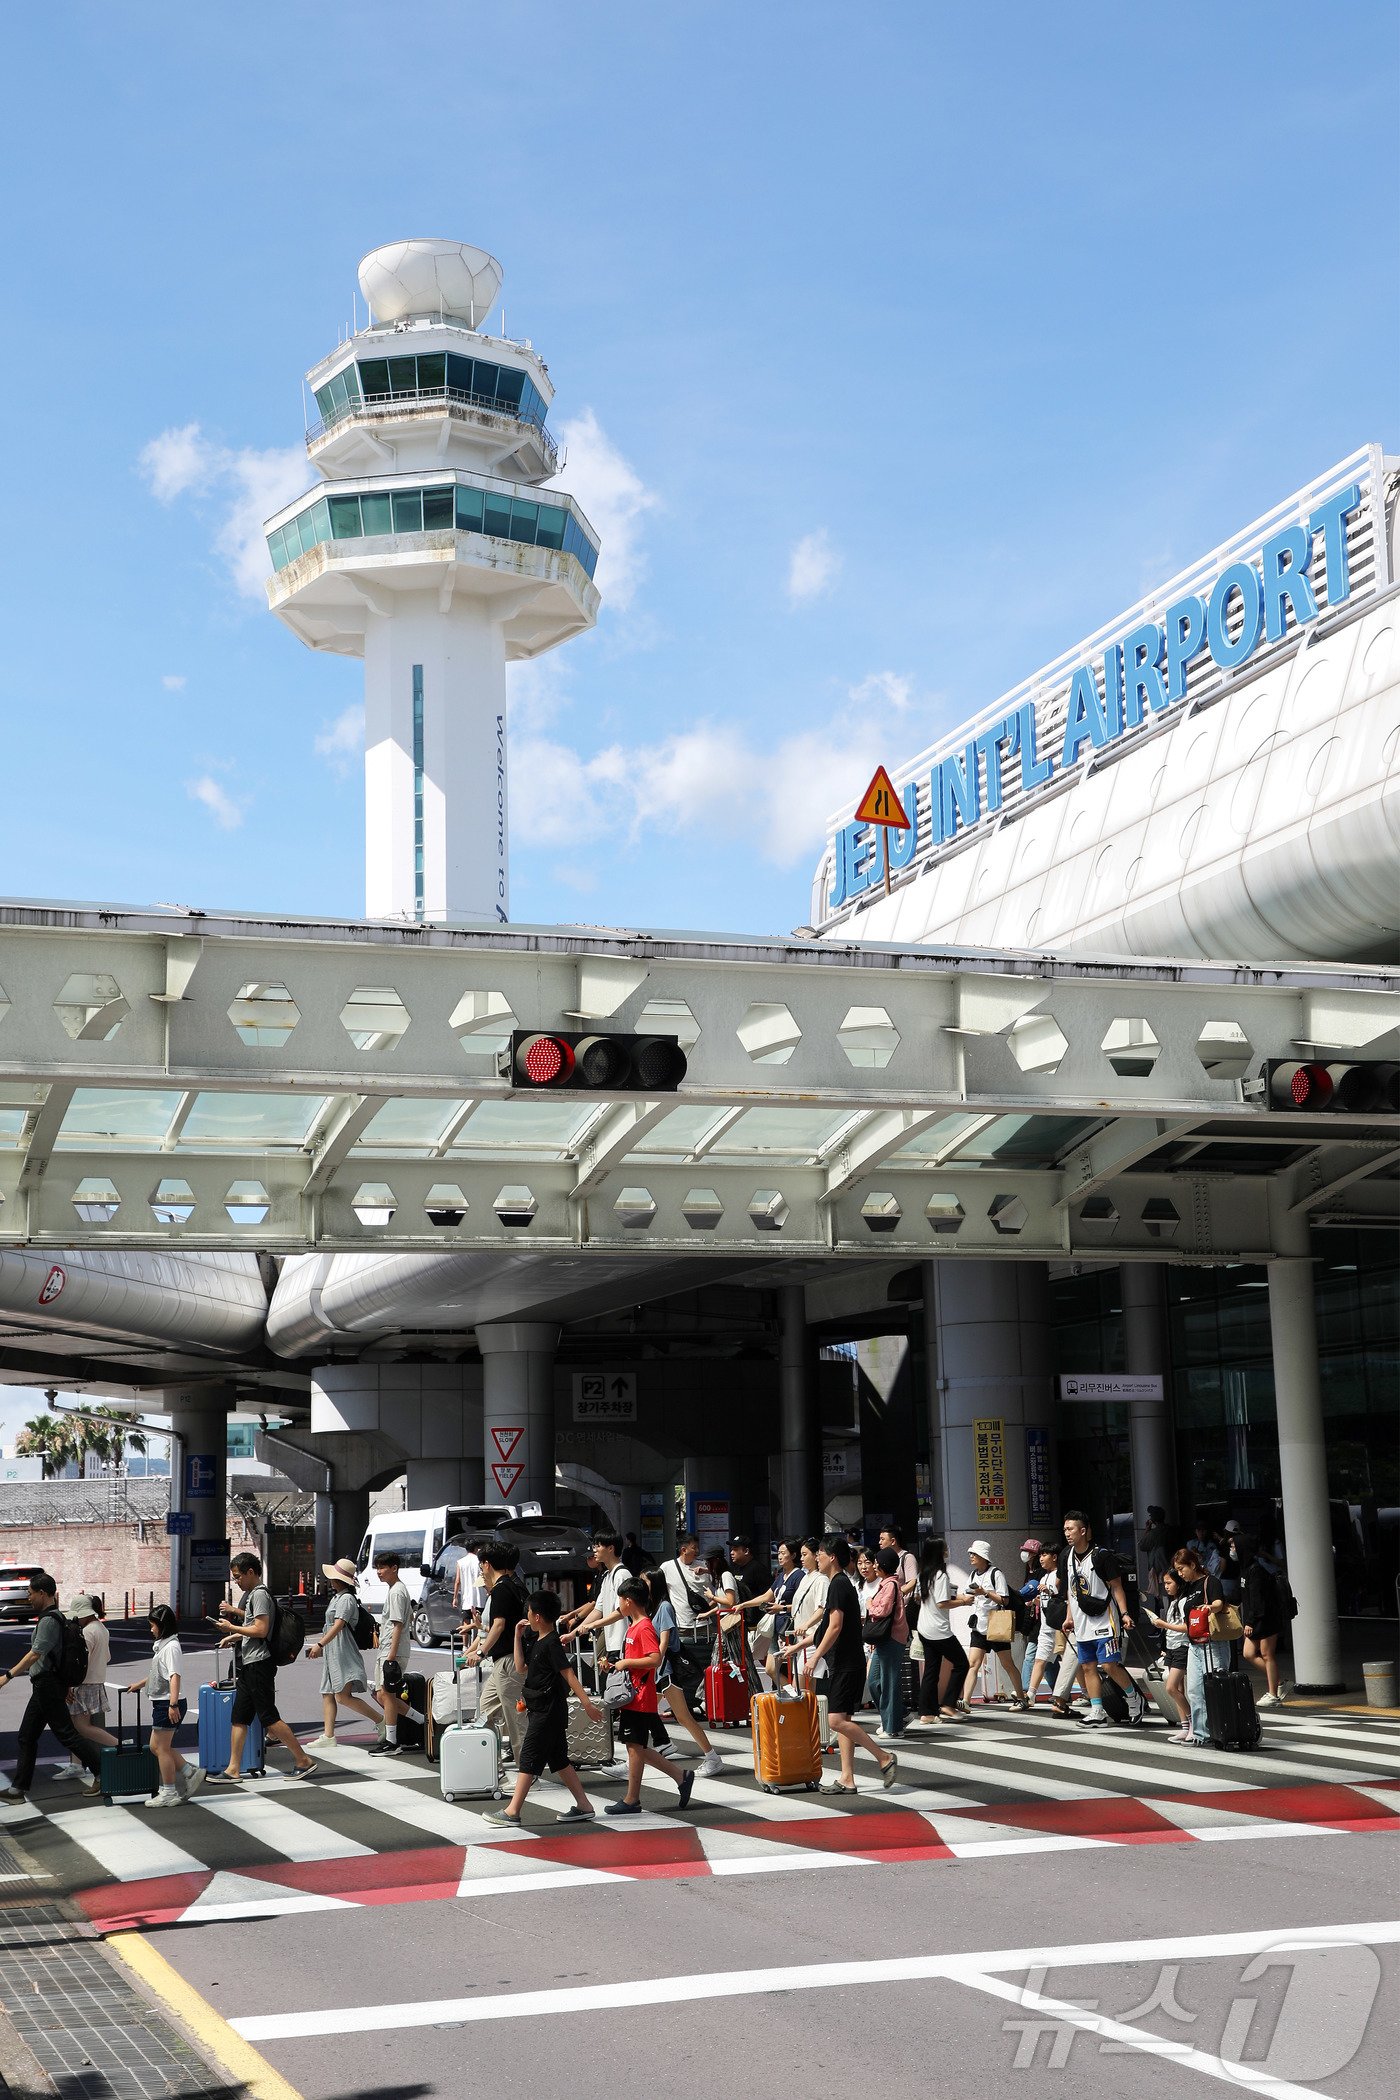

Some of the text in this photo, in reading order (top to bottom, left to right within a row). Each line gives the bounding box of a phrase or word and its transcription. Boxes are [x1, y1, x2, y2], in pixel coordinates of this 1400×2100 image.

[829, 484, 1361, 907] JEJU INT'L AIRPORT
[496, 715, 504, 856] Welcome
[497, 868, 505, 897] to
[584, 1381, 603, 1395] P2
[1080, 1382, 1121, 1393] 리무진버스
[577, 1401, 633, 1414] 장기주차장
[556, 1431, 575, 1444] DC
[977, 1433, 991, 1497] 불법주정차
[990, 1433, 1005, 1497] 무인단속중
[698, 1503, 711, 1512] 600
